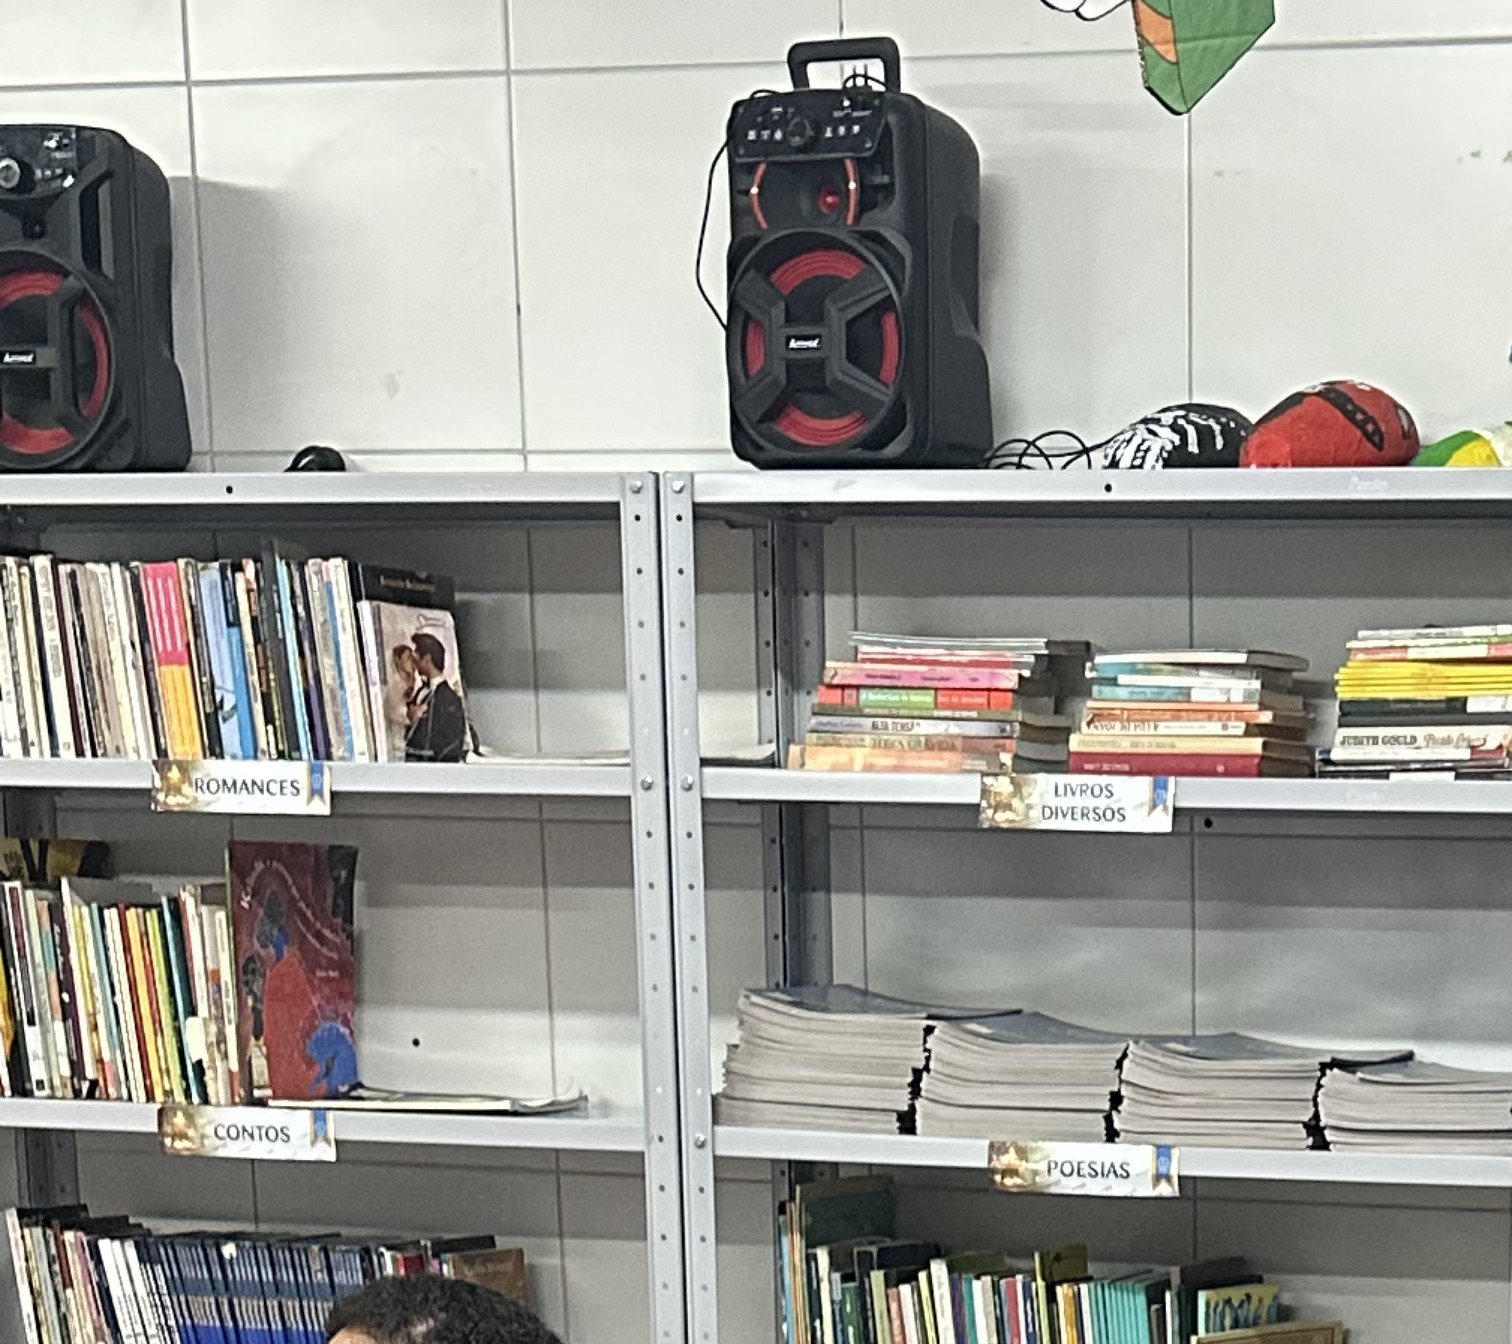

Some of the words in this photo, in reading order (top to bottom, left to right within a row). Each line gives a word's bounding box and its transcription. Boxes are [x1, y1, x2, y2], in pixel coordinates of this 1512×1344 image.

[195, 777, 300, 796] ROMANCES
[1055, 783, 1114, 799] LIVROS
[1042, 805, 1126, 822] DIVERSOS
[214, 1123, 290, 1143] CONTOS
[1047, 1160, 1130, 1179] POESIAS
